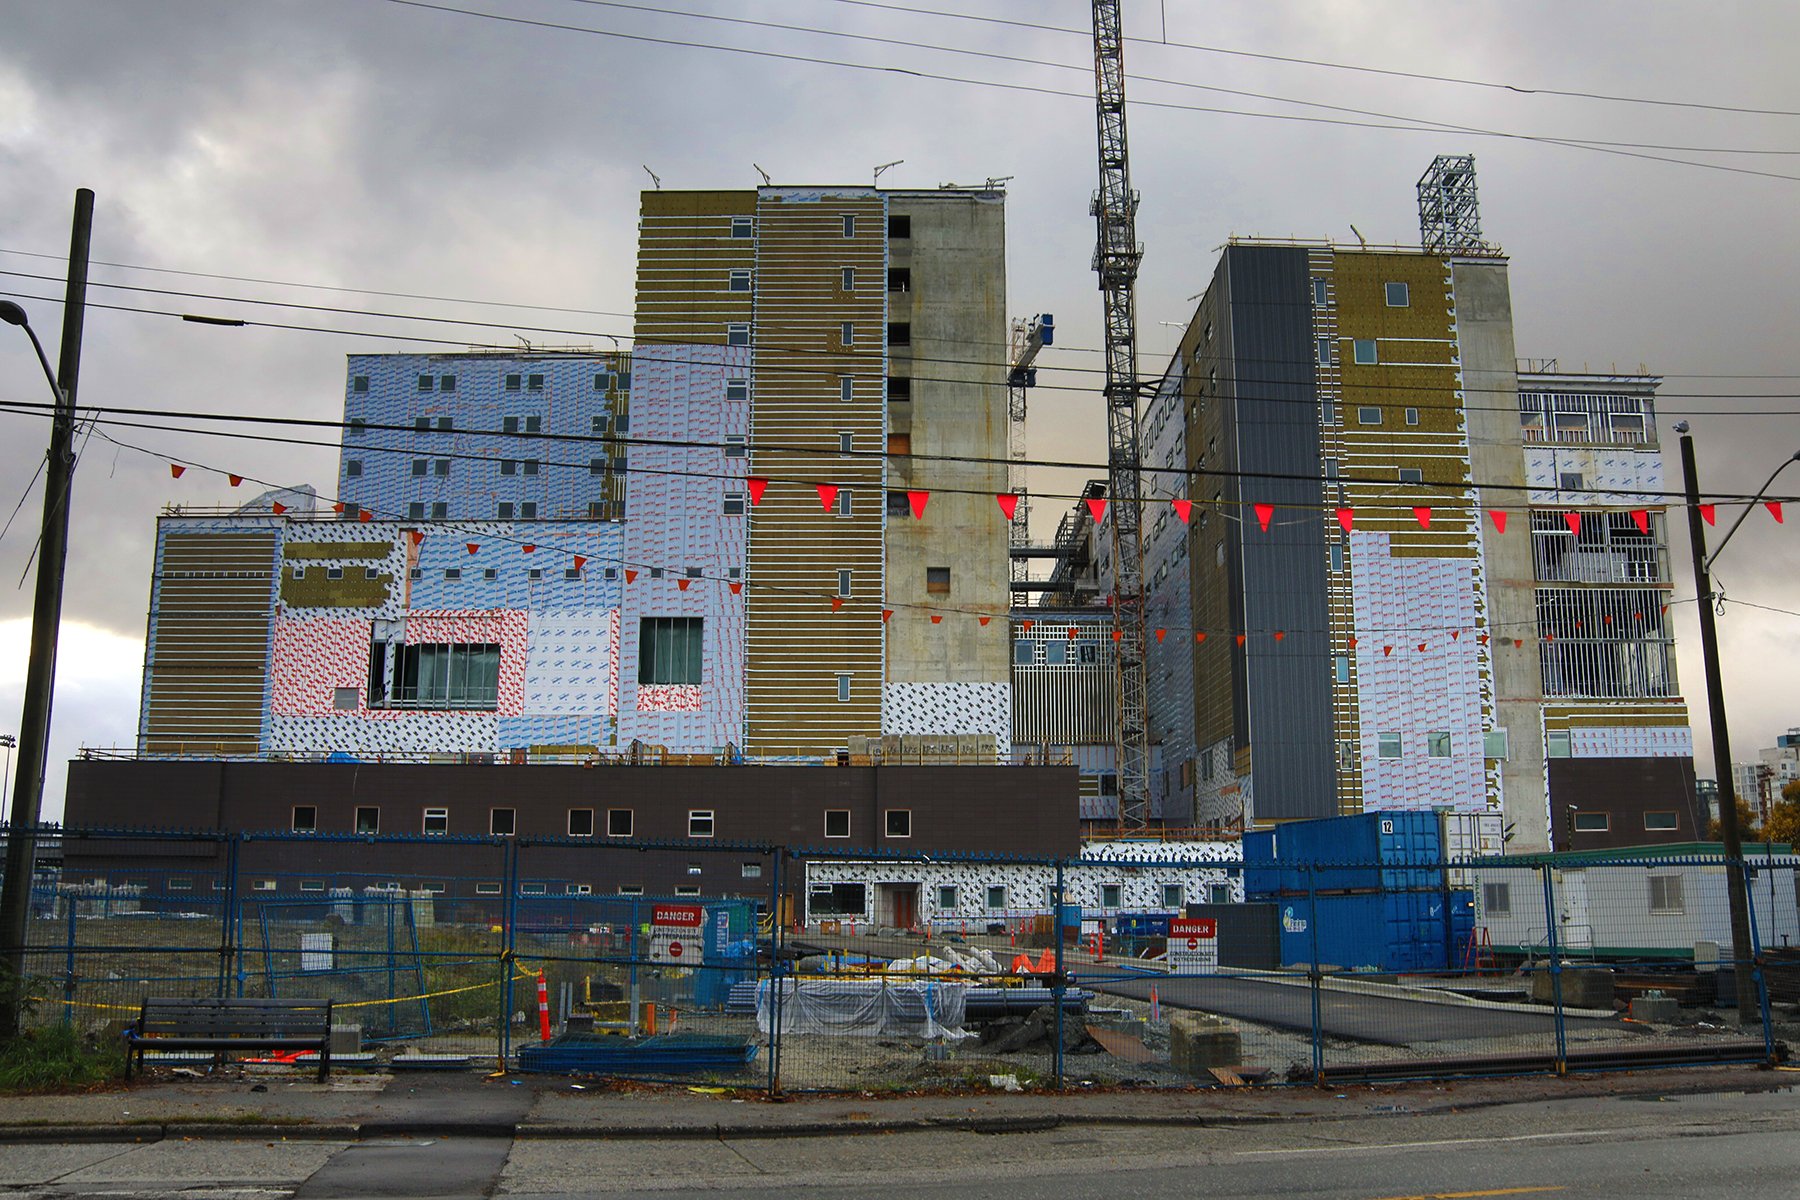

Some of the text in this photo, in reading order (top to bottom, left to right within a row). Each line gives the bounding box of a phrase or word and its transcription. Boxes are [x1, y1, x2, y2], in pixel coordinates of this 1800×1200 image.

[1383, 821, 1392, 833] 12
[656, 911, 695, 921] DANGER
[1173, 925, 1209, 933] DANGER
